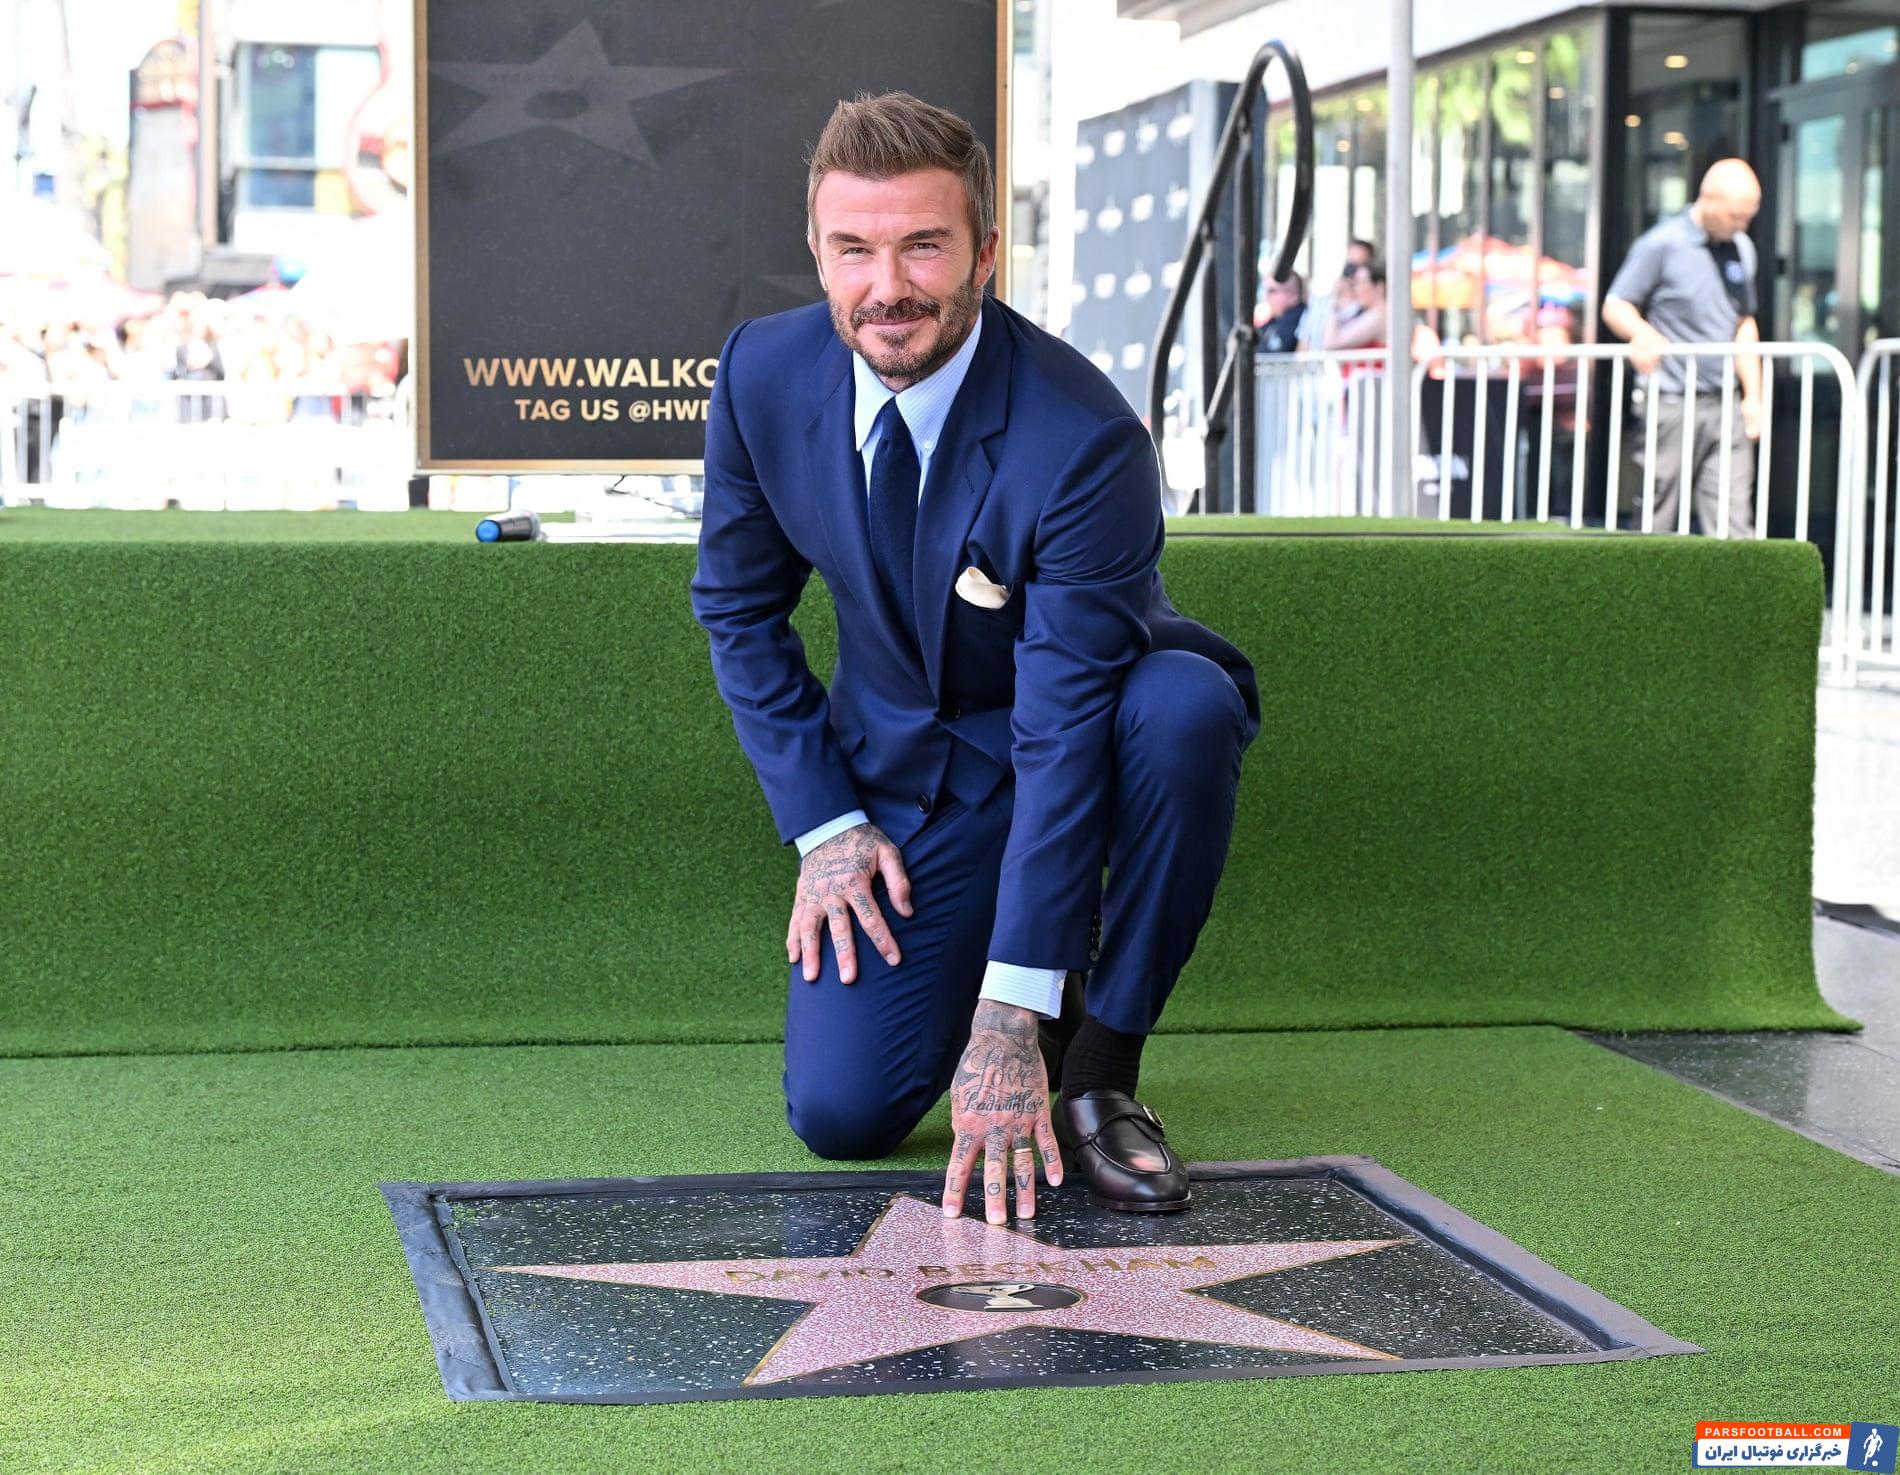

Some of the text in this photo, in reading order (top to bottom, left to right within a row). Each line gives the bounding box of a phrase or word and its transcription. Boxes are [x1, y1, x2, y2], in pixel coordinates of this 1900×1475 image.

[514, 399, 571, 421] TAG
[580, 399, 620, 421] US
[917, 1255, 1218, 1278] BECKHAM
